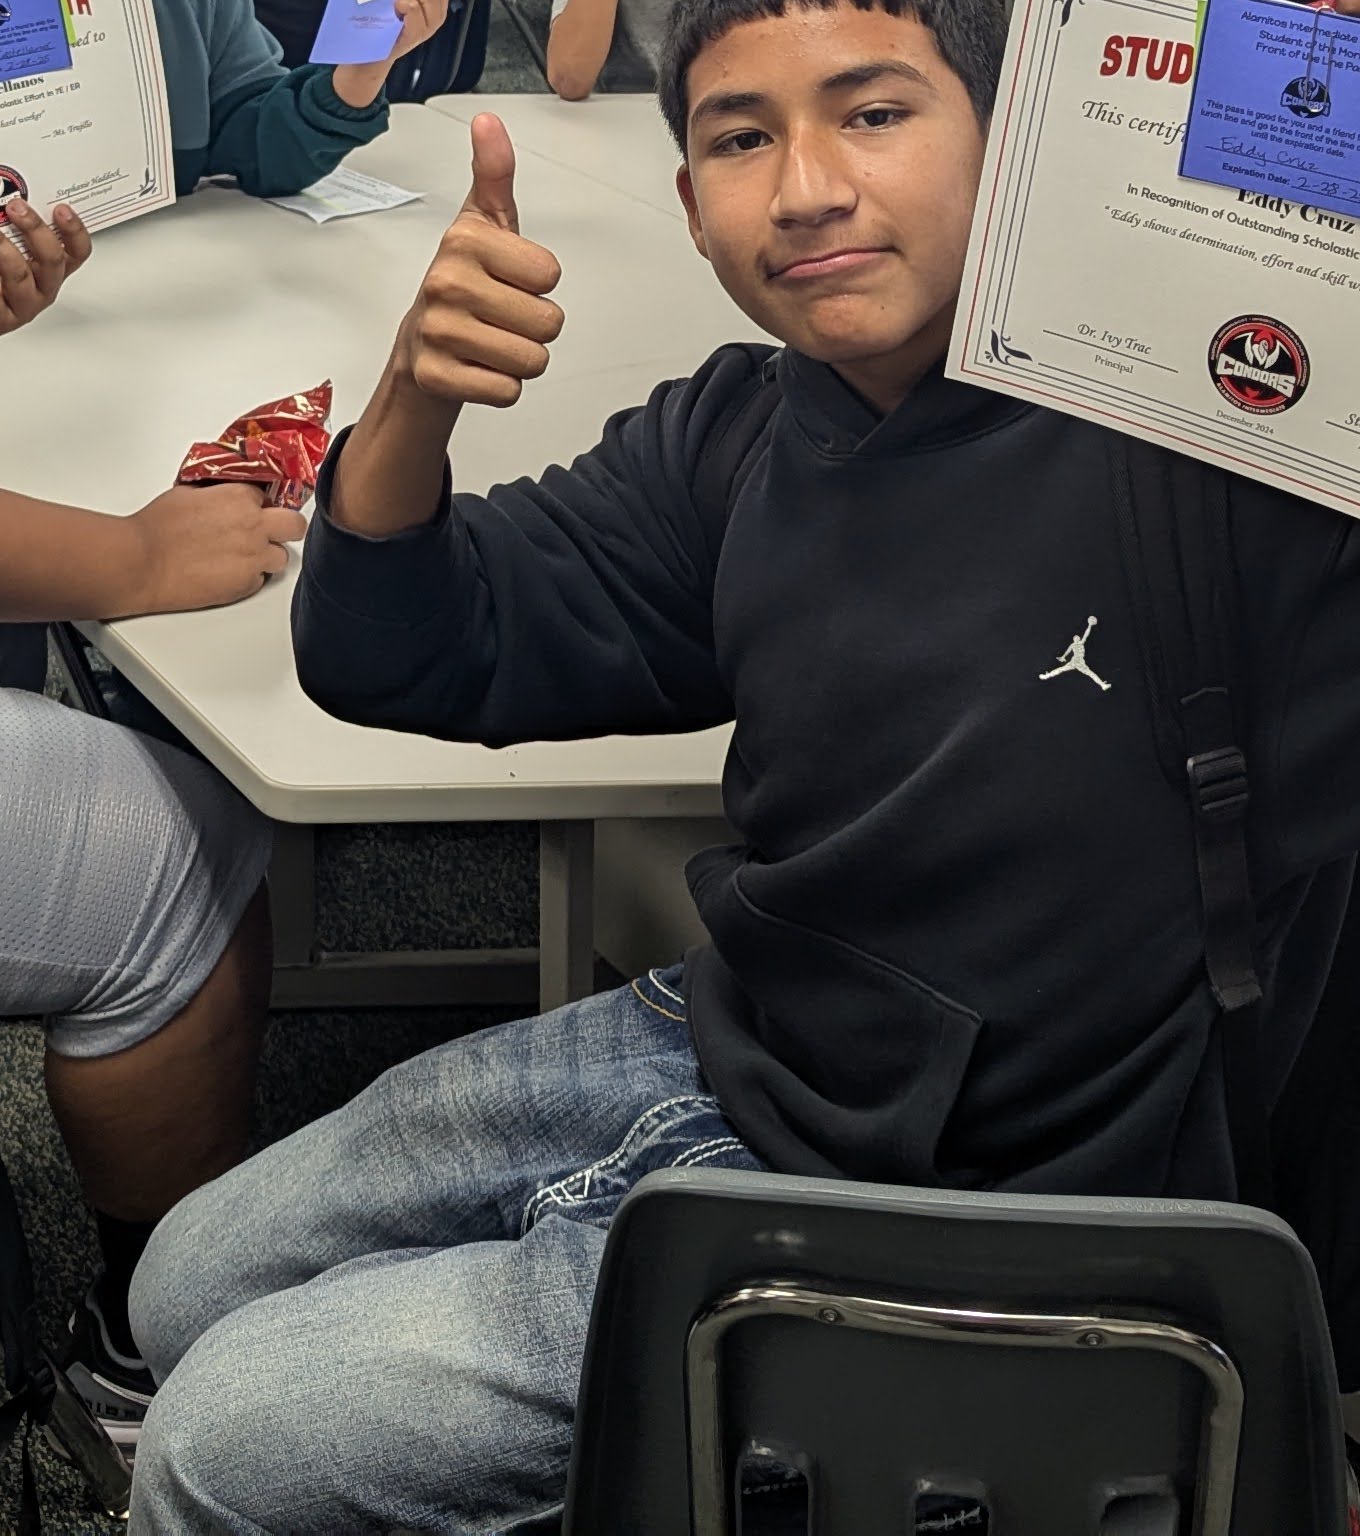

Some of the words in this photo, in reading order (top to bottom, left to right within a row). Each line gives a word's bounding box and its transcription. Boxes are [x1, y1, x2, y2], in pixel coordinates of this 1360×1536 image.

[93, 31, 107, 43] to
[1241, 10, 1288, 30] Alamitos
[1289, 21, 1358, 45] Intermediate
[1258, 30, 1304, 48] Student
[1319, 42, 1337, 54] the
[1100, 34, 1195, 84] STUD
[1256, 42, 1287, 57] Front
[1289, 49, 1302, 60] of
[24, 91, 45, 104] Effort
[1081, 100, 1125, 127] This
[1128, 115, 1188, 146] certif
[1220, 136, 1267, 167] Eddy
[1277, 150, 1319, 171] Cruz
[1269, 133, 1283, 145] the
[1284, 138, 1324, 154] expiration
[1325, 146, 1346, 159] date.
[1222, 162, 1266, 181] Expiration
[1267, 172, 1291, 186] Date:
[1127, 183, 1138, 195] In
[1141, 185, 1209, 216] Recognition
[1212, 208, 1225, 220] of
[1227, 211, 1299, 243] Outstanding
[1302, 233, 1360, 261] Scholastic
[1236, 187, 1297, 219] Eddy
[1299, 203, 1357, 234] Cruz
[1111, 208, 1141, 228] Eddy
[1142, 216, 1178, 237] shows
[1179, 228, 1259, 262] determination,
[1261, 253, 1295, 274] effort
[1295, 263, 1324, 279] and
[1320, 268, 1350, 288] skill
[1077, 323, 1097, 339] Dr.
[1101, 331, 1123, 349] Ivy
[1124, 337, 1152, 355] Trac
[1094, 354, 1135, 375] Principal
[1216, 352, 1297, 398] CONDORS
[1216, 409, 1254, 428] December
[1255, 422, 1275, 435] 2024
